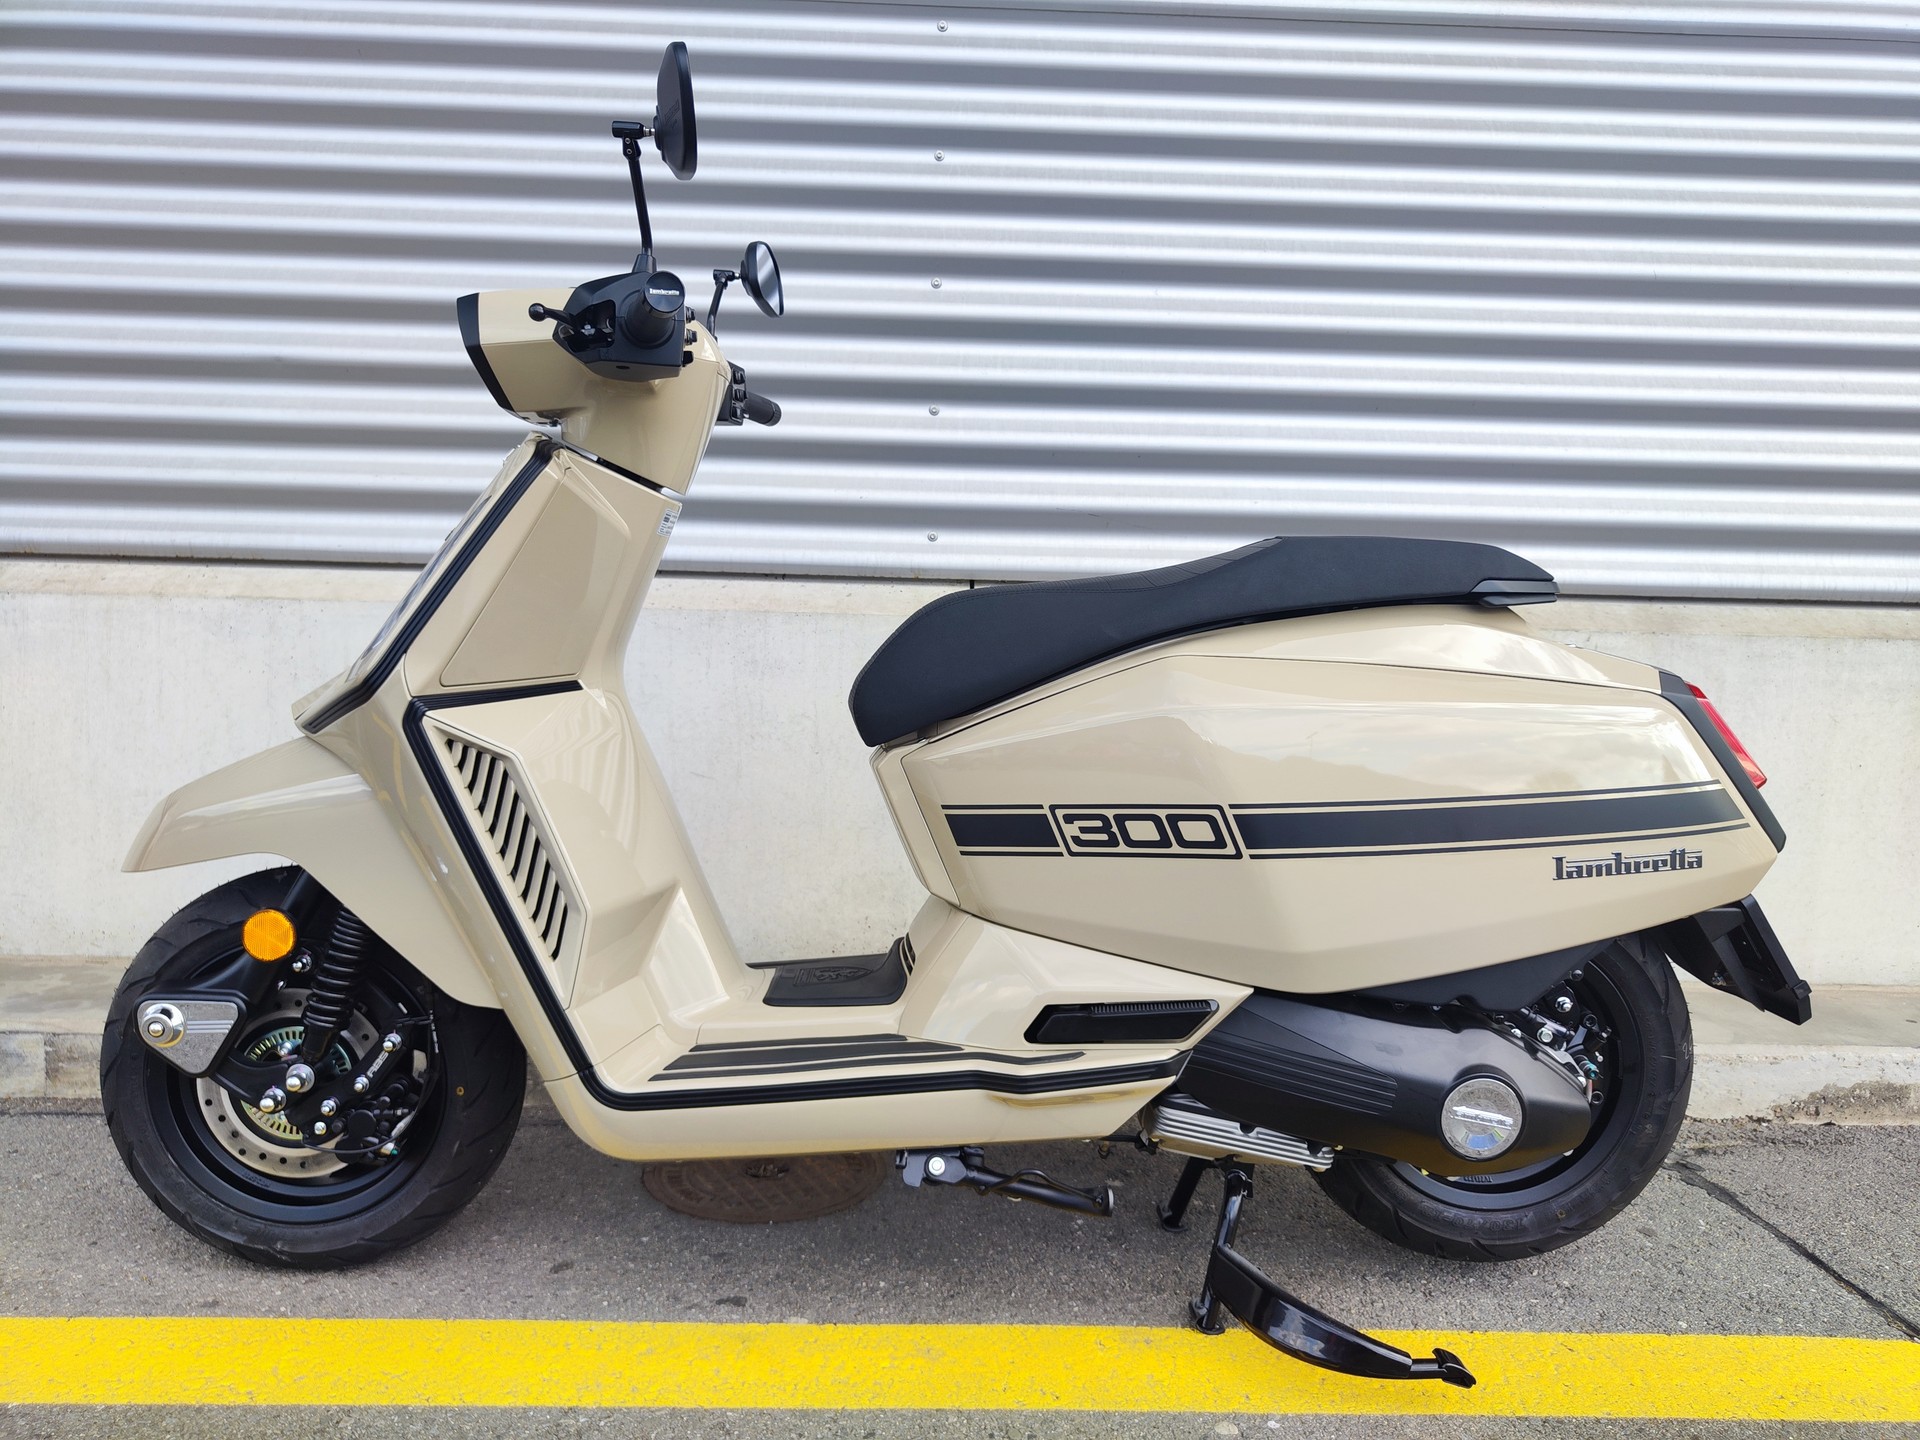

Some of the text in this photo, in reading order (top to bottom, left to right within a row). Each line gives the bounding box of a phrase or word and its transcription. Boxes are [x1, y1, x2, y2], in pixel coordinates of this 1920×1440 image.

[1062, 813, 1228, 850] 300
[1552, 848, 1703, 881] Lambretta
[366, 1050, 389, 1078] ABS
